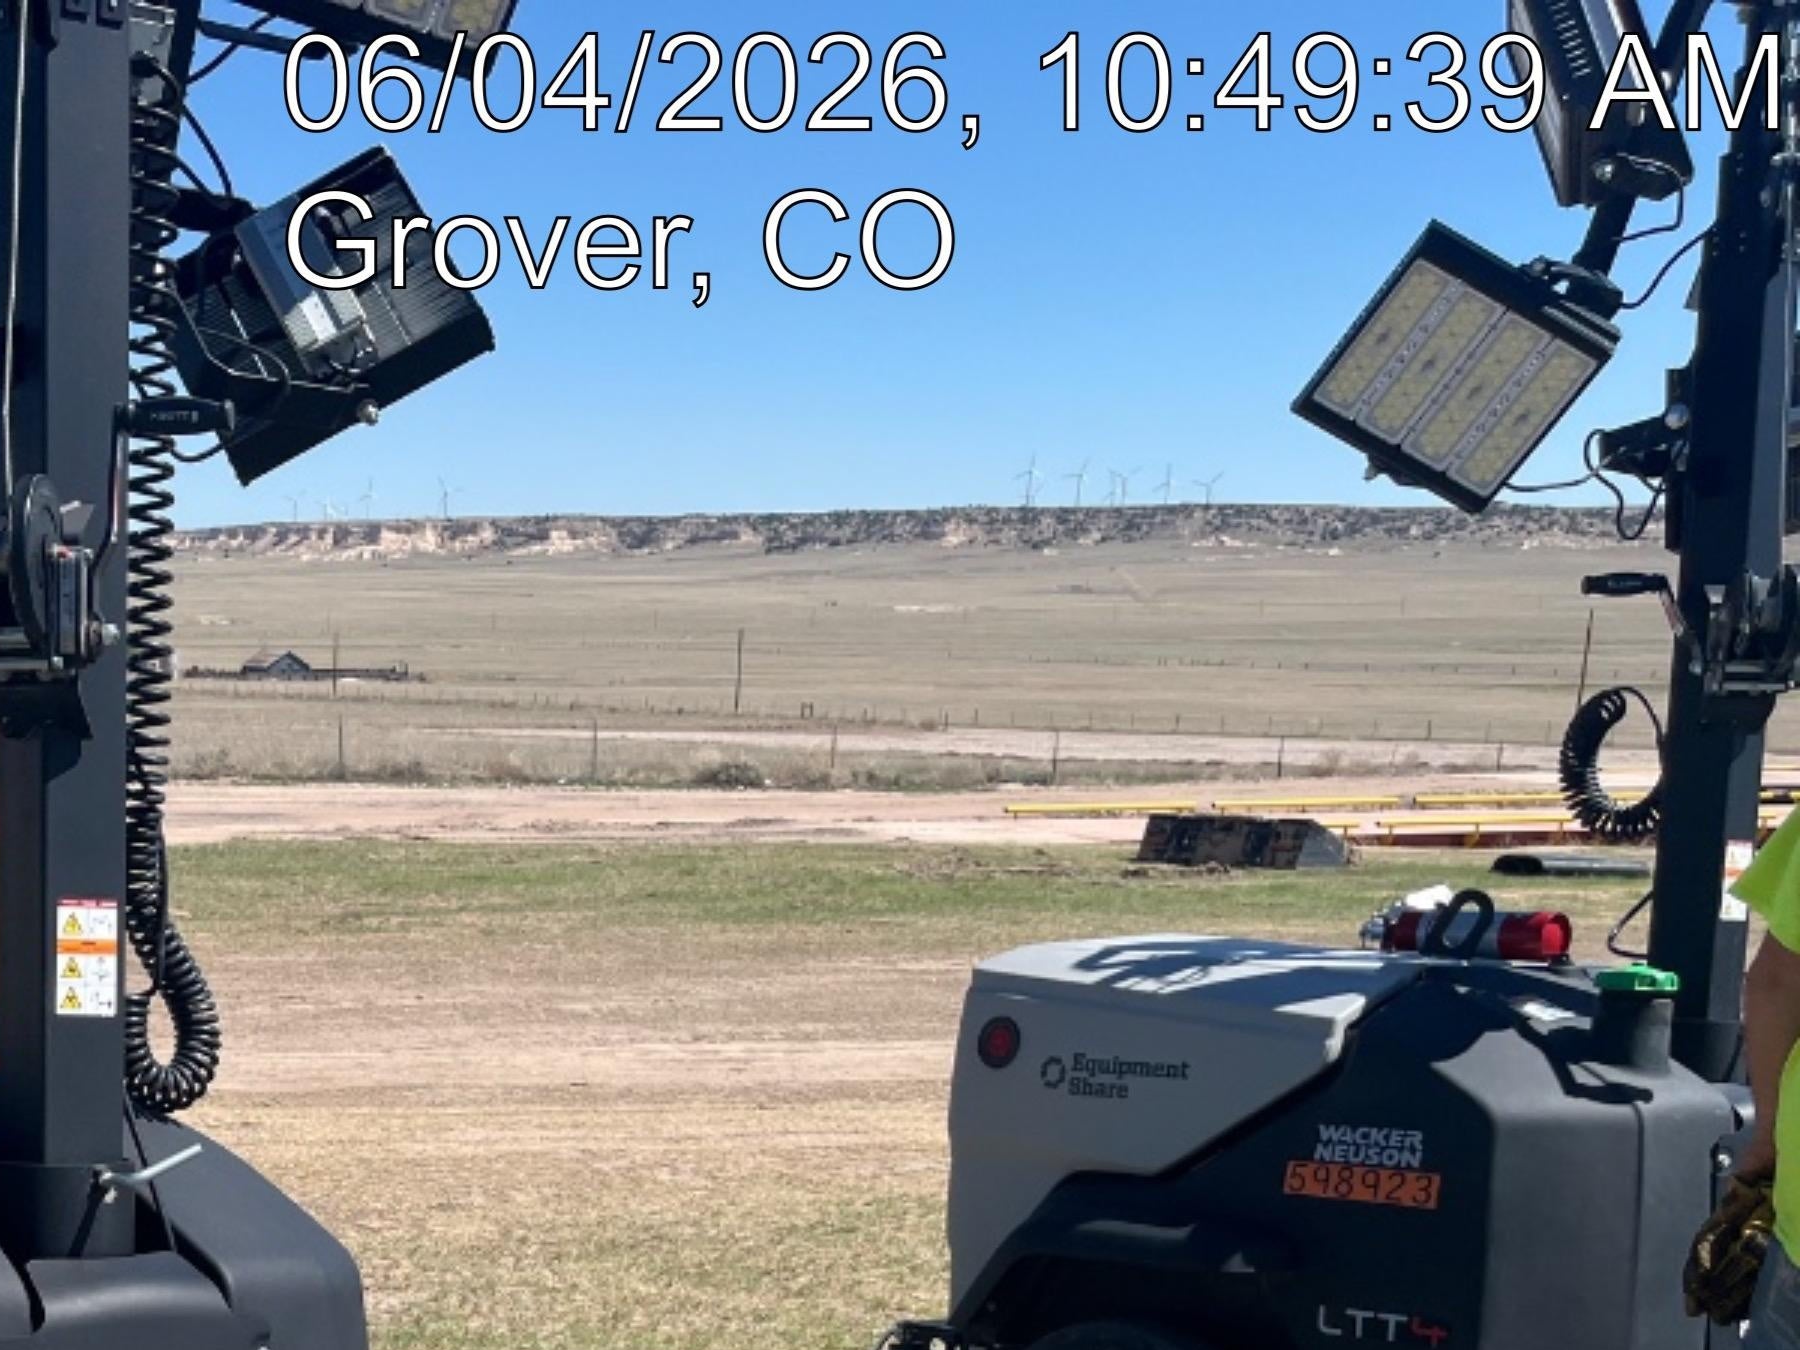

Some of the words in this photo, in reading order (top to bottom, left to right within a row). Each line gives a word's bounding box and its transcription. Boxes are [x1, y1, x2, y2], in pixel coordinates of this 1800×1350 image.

[1071, 1052, 1191, 1080] Equipment
[1068, 1077, 1129, 1098] Share
[1318, 1124, 1423, 1148] WACKER
[1313, 1143, 1423, 1168] NEUSON
[1318, 1304, 1448, 1349] LTT4
